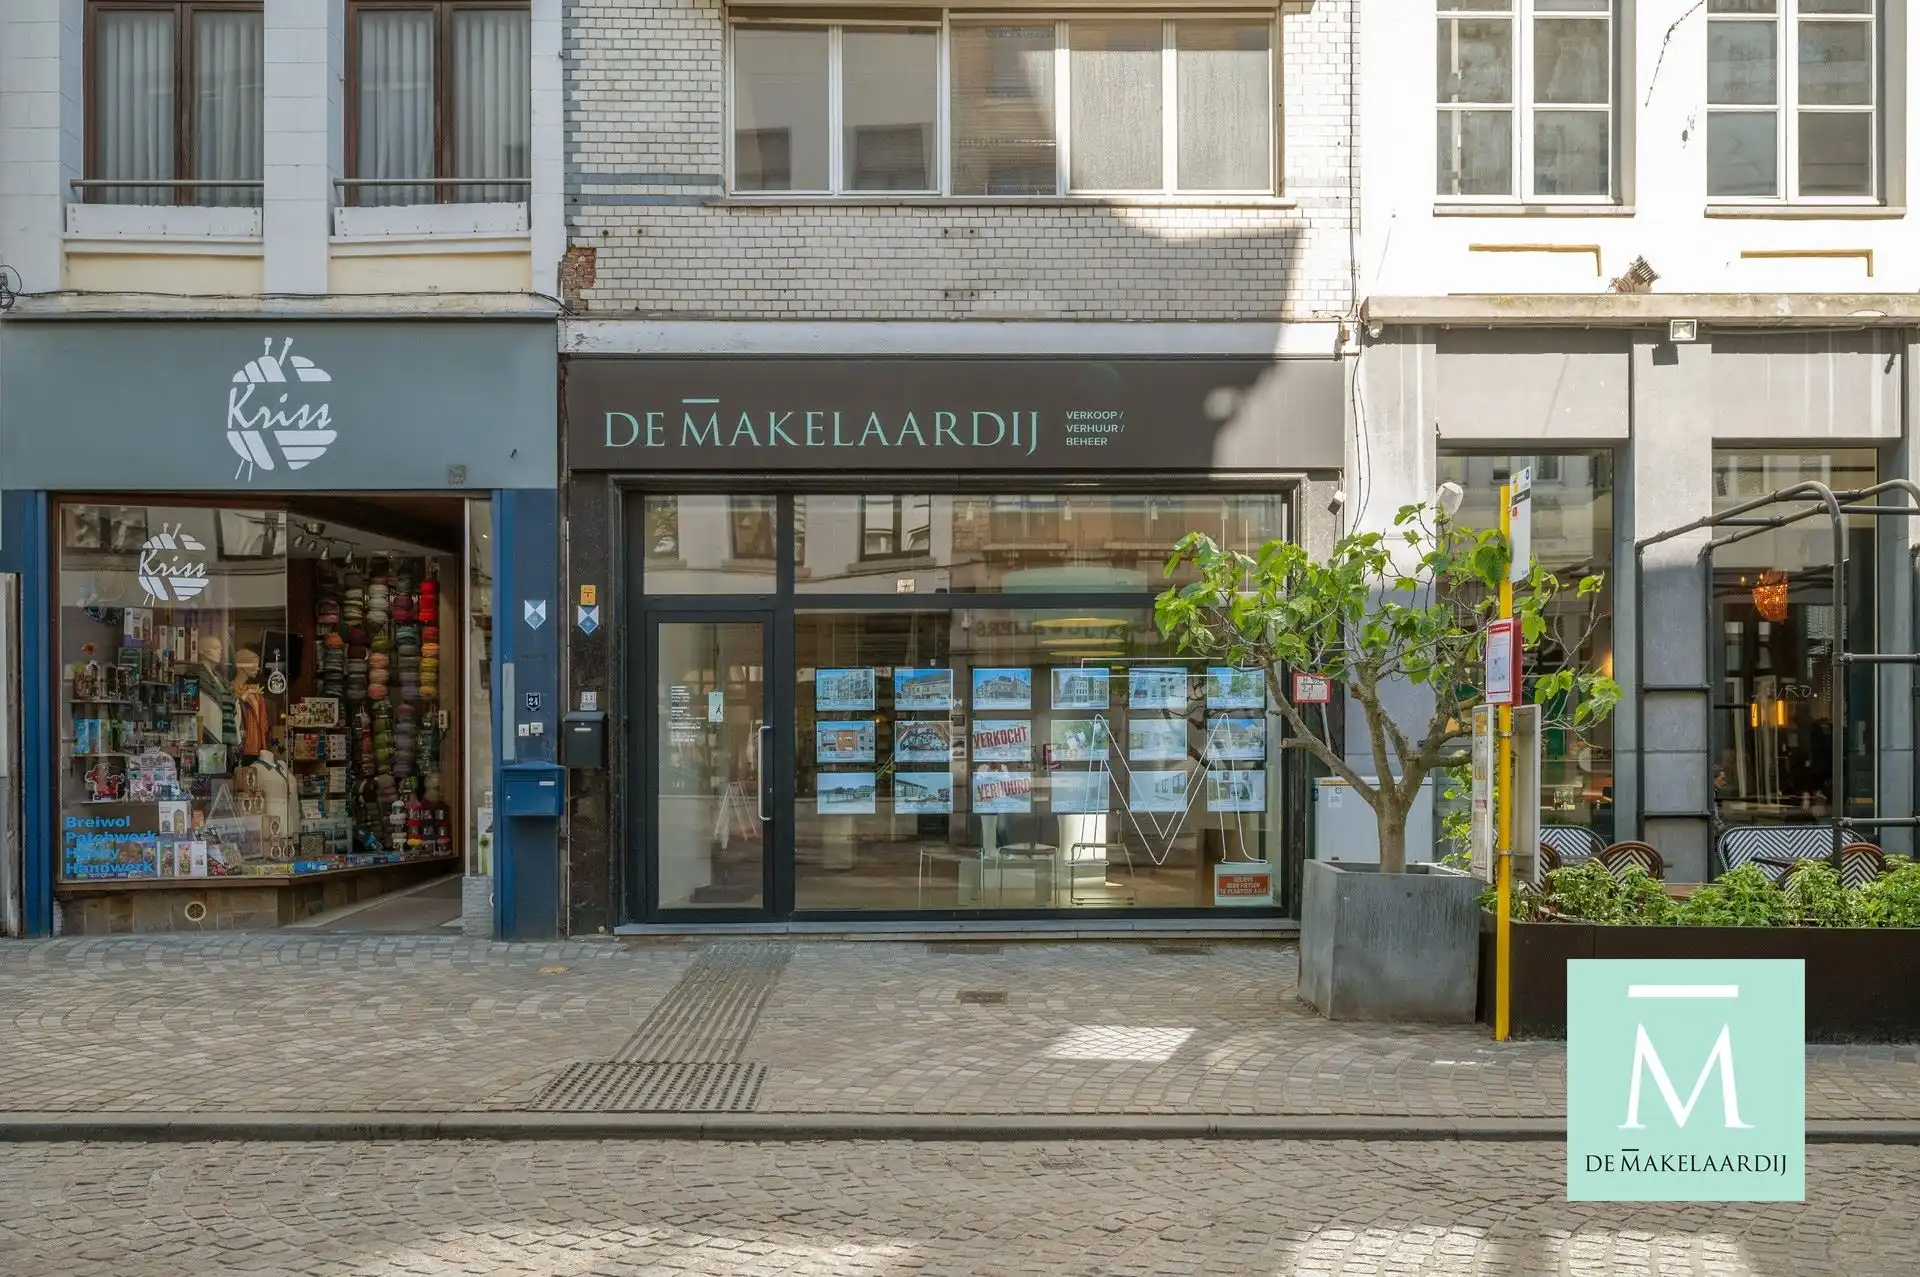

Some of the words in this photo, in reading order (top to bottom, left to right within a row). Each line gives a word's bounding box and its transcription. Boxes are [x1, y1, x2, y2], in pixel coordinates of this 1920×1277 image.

[227, 383, 332, 429] Kriss
[1065, 410, 1118, 420] VERKOOP
[604, 411, 665, 447] DE
[679, 411, 1039, 456] MAKELAARDIJ
[1065, 424, 1118, 433] VERHUUR
[1066, 437, 1108, 446] BEHEER
[139, 549, 206, 577] Kriss
[973, 727, 1027, 749] VERKOCHT
[977, 778, 1031, 801] VERHUURD
[65, 815, 131, 828] Breiwol
